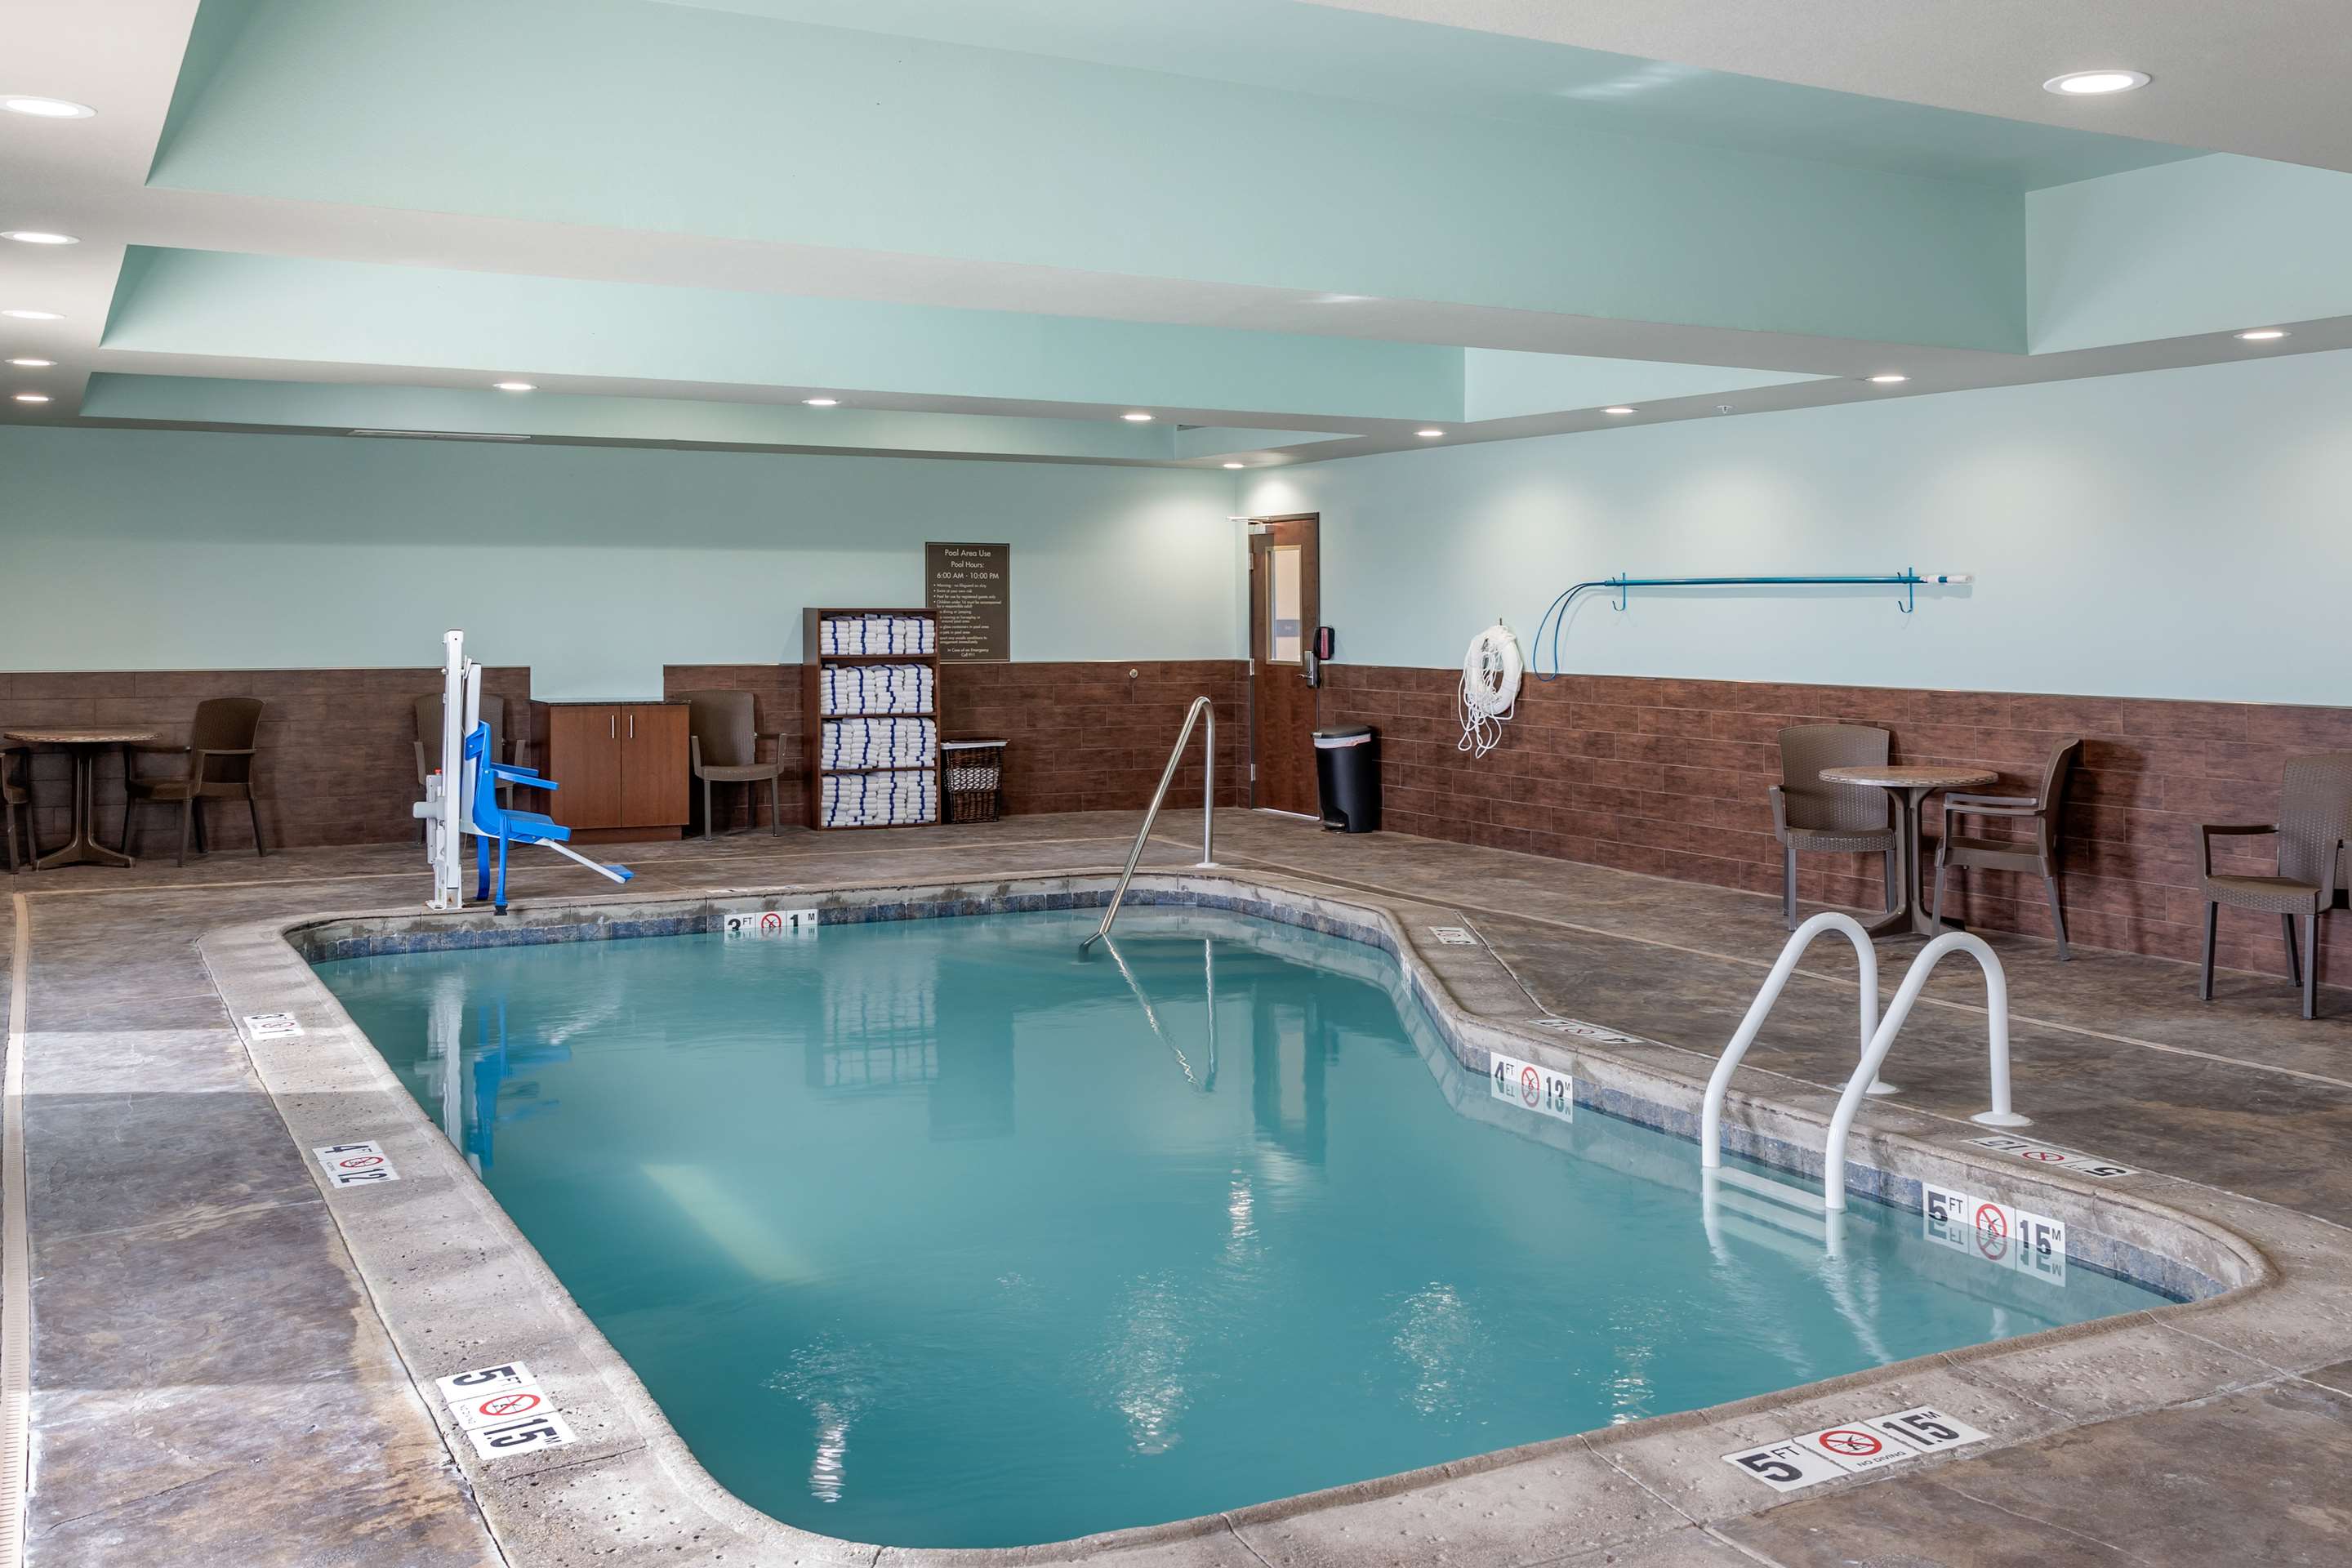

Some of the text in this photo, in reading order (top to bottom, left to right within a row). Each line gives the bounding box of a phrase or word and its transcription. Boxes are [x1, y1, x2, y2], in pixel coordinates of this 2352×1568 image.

[944, 548, 960, 556] Pool
[979, 549, 991, 557] Use
[970, 572, 988, 580] 10:00
[989, 572, 1000, 580] PM
[742, 916, 753, 926] FT
[790, 912, 815, 928] 1 M
[1494, 1061, 1516, 1082] 4 FT
[324, 1145, 370, 1154] 4
[1927, 1190, 1964, 1223] 5 FT
[2051, 1229, 2062, 1242] M
[452, 1365, 517, 1387] 5
[1922, 1411, 1942, 1422] M
[1873, 1451, 1908, 1463] DIVING
[1736, 1446, 1803, 1483] 5 FT
